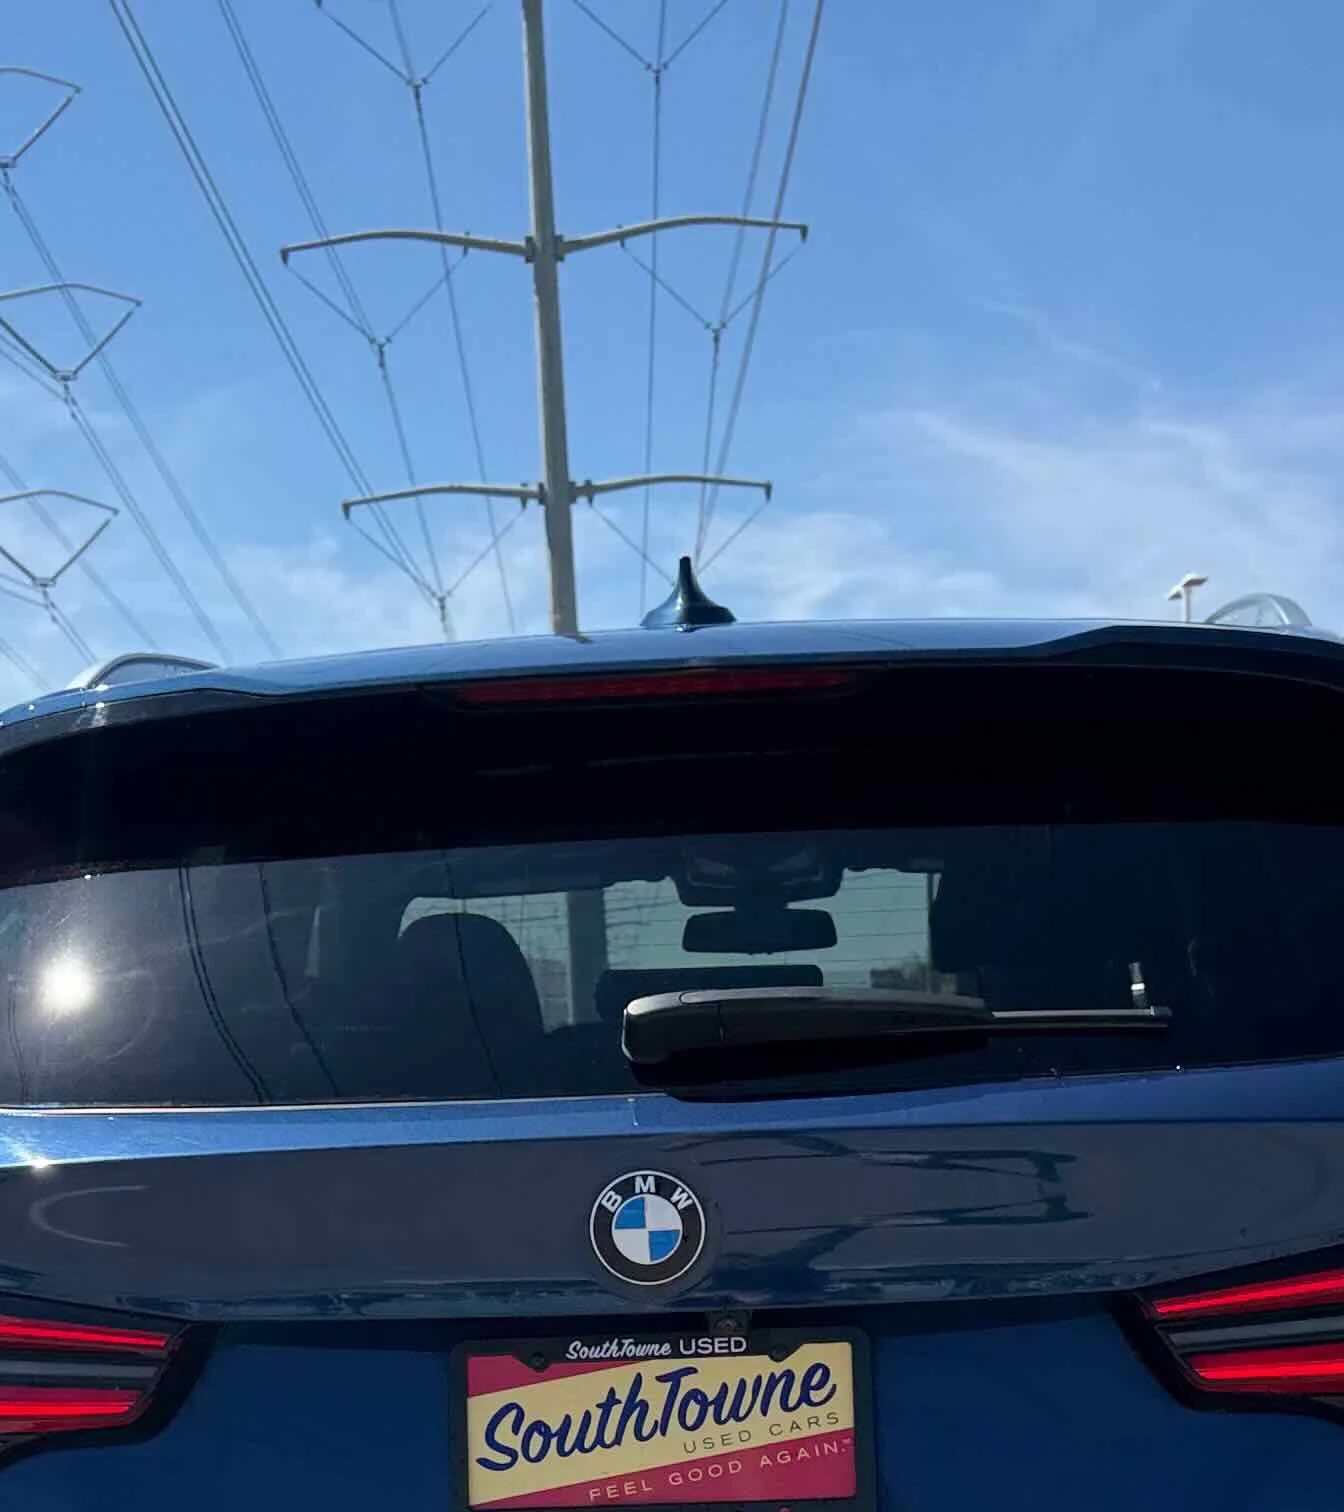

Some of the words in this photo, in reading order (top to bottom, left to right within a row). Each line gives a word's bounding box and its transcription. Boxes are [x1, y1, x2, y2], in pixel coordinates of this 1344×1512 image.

[600, 1175, 694, 1213] BMW
[565, 1337, 672, 1360] SouthTowne
[679, 1336, 747, 1355] USED
[475, 1361, 837, 1472] SouthTowne
[683, 1430, 752, 1454] USED
[768, 1411, 840, 1437] CARS
[589, 1478, 652, 1502] FEEL
[669, 1460, 742, 1485] GOOD
